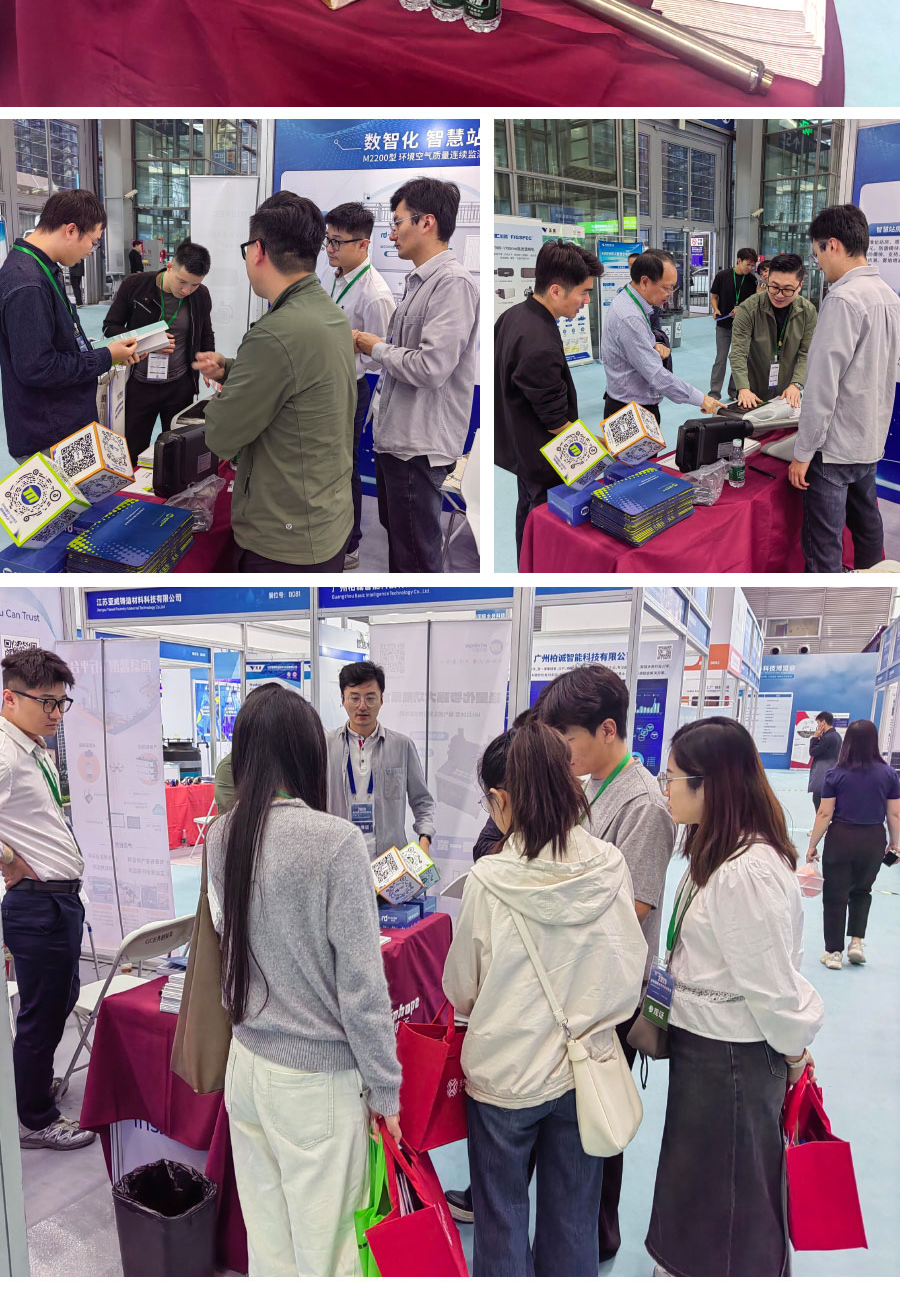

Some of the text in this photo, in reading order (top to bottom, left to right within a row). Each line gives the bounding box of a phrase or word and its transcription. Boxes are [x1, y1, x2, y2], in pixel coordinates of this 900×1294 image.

[364, 131, 420, 151] 数智化
[398, 149, 480, 162] 环境空气质量连续监
[6, 609, 21, 619] Can
[22, 611, 40, 622] Trust
[533, 652, 628, 663] 广州柏诚智能科技有限公
